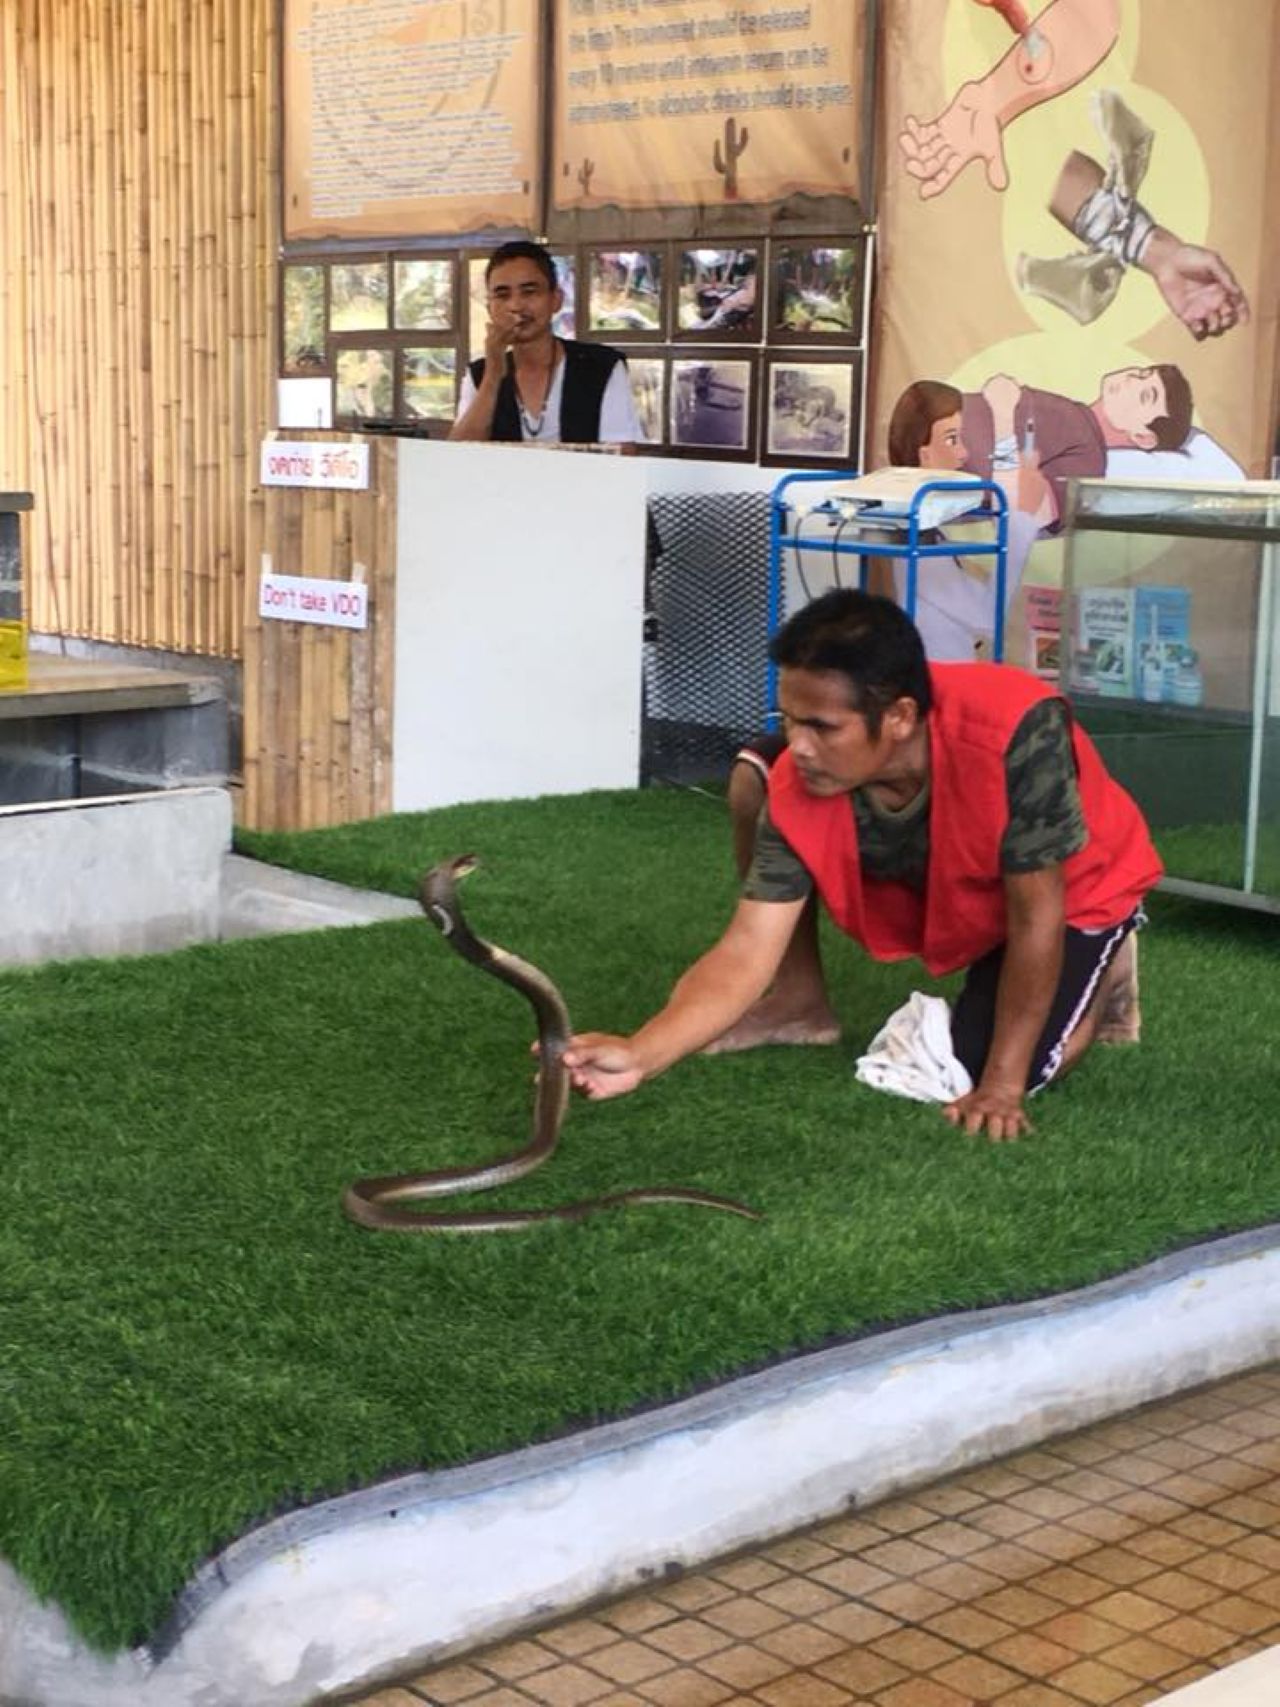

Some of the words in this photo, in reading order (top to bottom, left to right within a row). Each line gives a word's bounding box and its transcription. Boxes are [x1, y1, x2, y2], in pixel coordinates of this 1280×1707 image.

[697, 11, 737, 38] should
[739, 10, 757, 34] be
[264, 583, 297, 608] Don't
[299, 589, 327, 612] take
[332, 592, 361, 616] VDO
